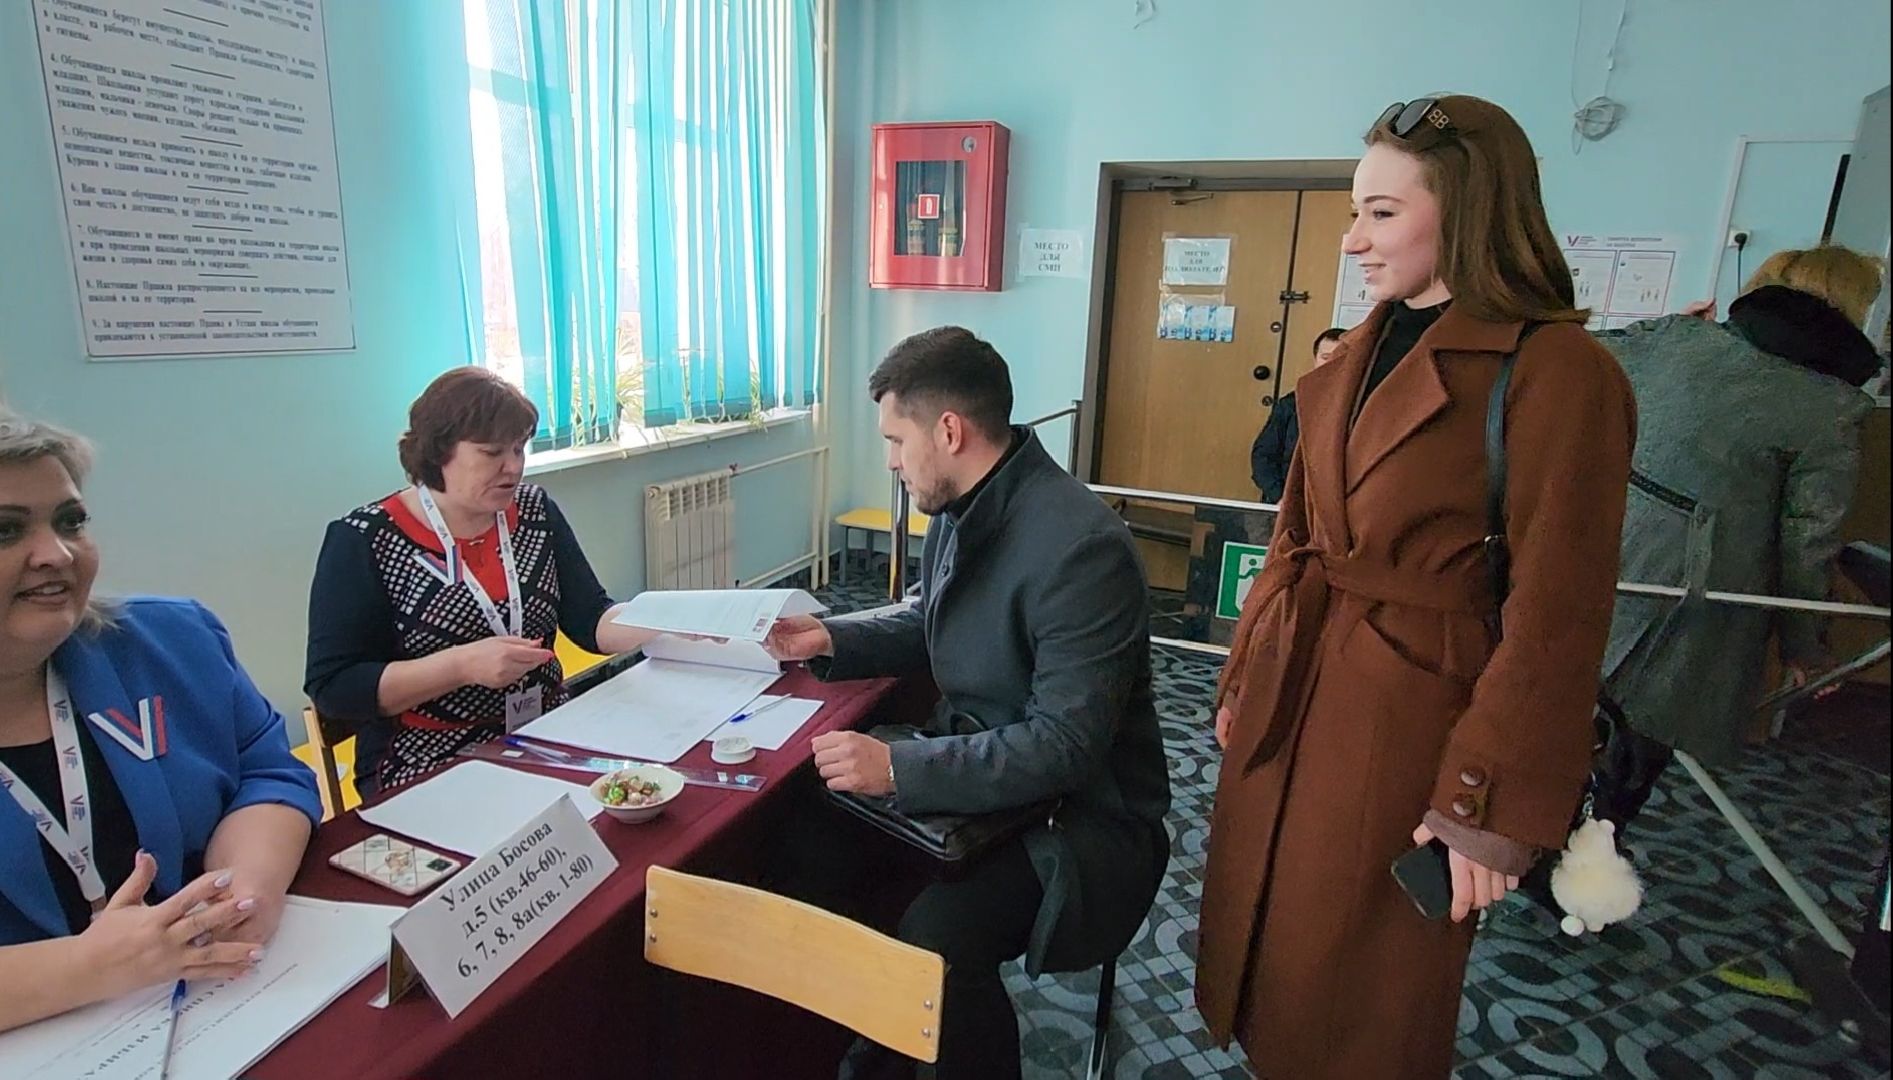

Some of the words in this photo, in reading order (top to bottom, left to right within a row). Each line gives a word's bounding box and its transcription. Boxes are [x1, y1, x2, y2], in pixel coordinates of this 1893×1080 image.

[1035, 242, 1069, 250] МЕСТО
[1040, 253, 1061, 261] ДЛЯ
[1038, 264, 1061, 272] СМИ
[440, 864, 500, 912] Улица
[499, 821, 553, 868] Босова
[457, 957, 479, 979] 6,
[475, 940, 498, 961] 7,
[493, 926, 516, 946] 8,
[511, 890, 561, 931] 8а(кв.
[558, 854, 594, 890] 1-80)
[462, 905, 488, 939] д.5
